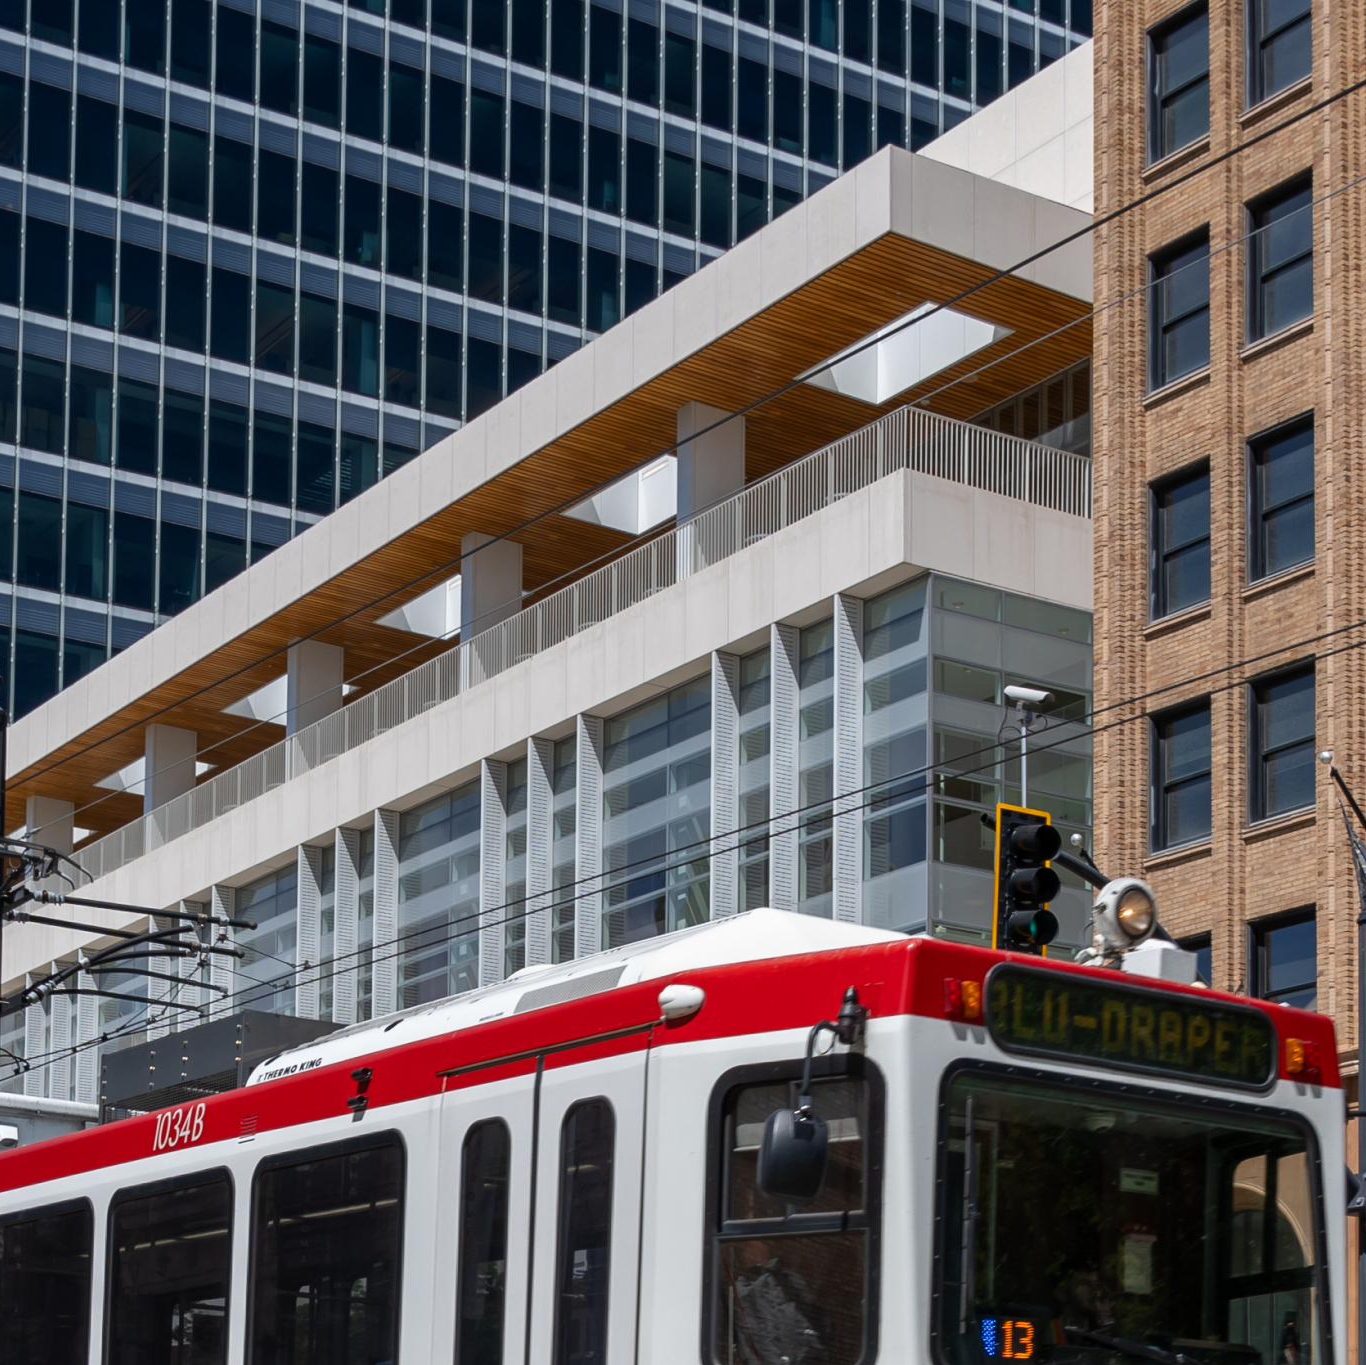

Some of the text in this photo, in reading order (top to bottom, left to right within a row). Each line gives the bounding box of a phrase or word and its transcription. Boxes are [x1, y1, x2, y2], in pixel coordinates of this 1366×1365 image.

[264, 1058, 323, 1081] THERMO KING
[153, 1103, 206, 1151] 1034B
[1001, 1319, 1035, 1360] 13
